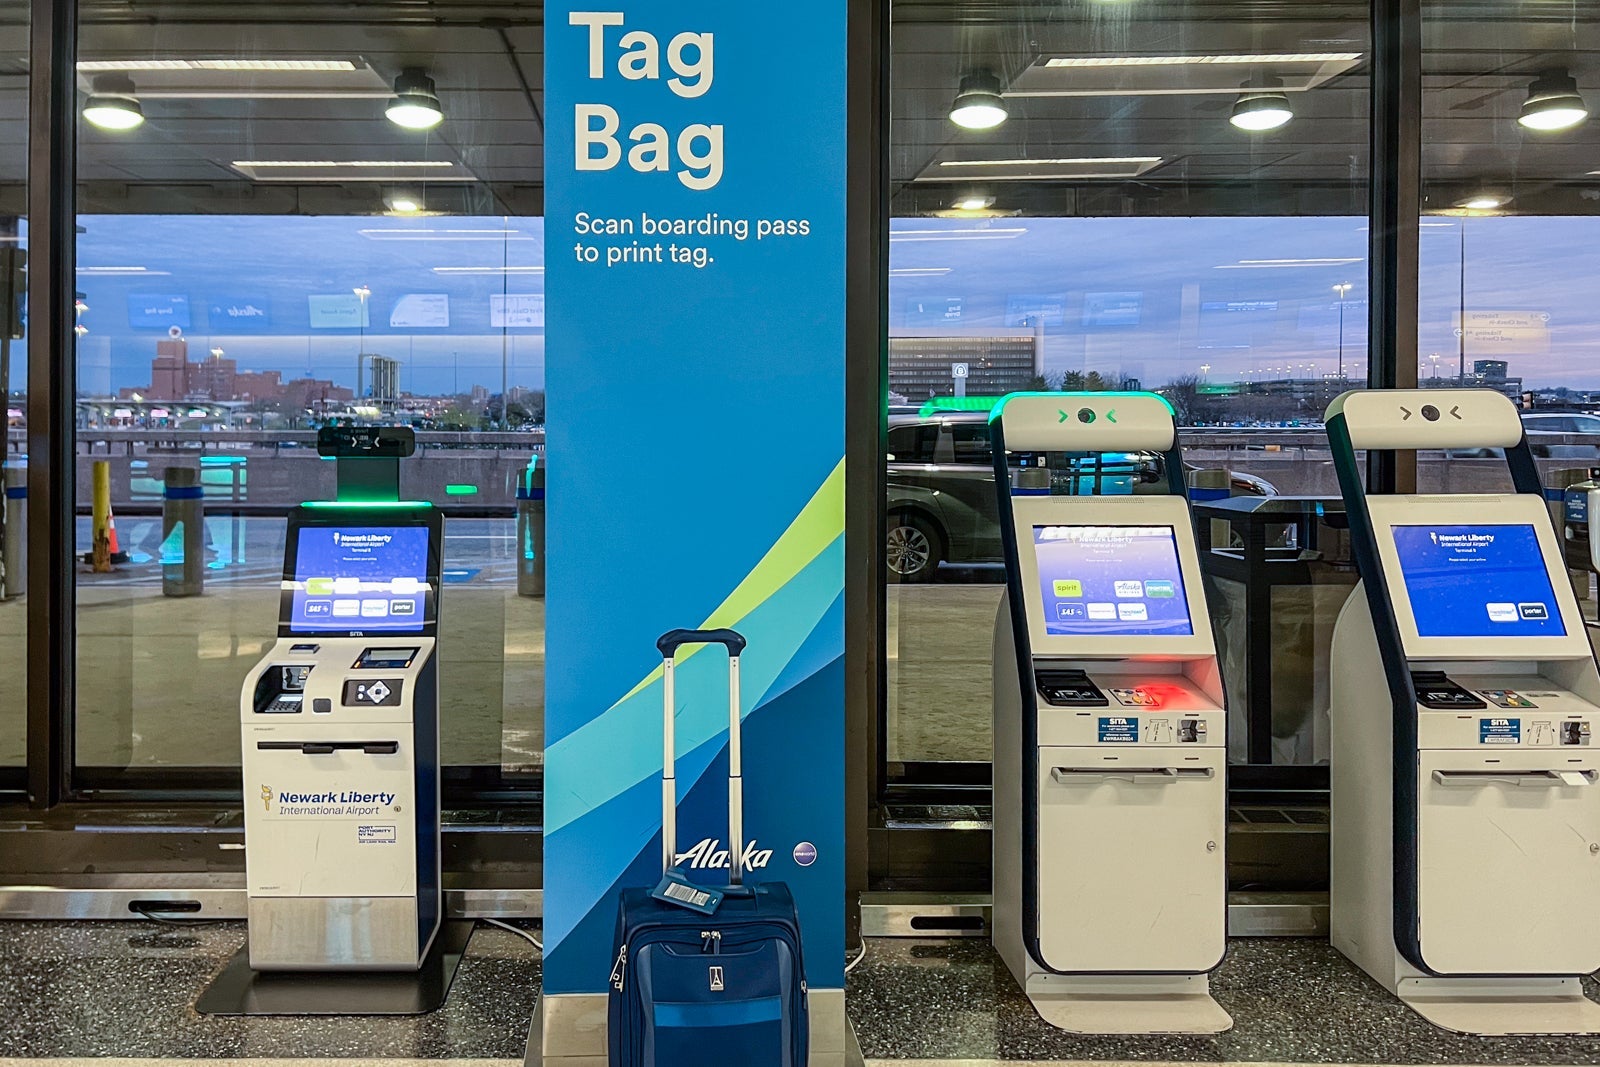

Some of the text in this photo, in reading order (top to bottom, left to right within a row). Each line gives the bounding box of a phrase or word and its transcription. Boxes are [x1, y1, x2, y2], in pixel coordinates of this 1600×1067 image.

[568, 11, 714, 98] Tag
[575, 103, 724, 191] Bag
[574, 212, 810, 241] Scan boarding pass
[574, 240, 714, 268] to print tag.
[341, 534, 391, 543] Newark Liberty
[1107, 535, 1133, 543] Liberty
[1468, 534, 1494, 542] Liberty
[1117, 582, 1141, 590] Alaska
[307, 605, 321, 613] SAS
[279, 791, 396, 806] Newark Liberty
[279, 806, 380, 816] International Airport
